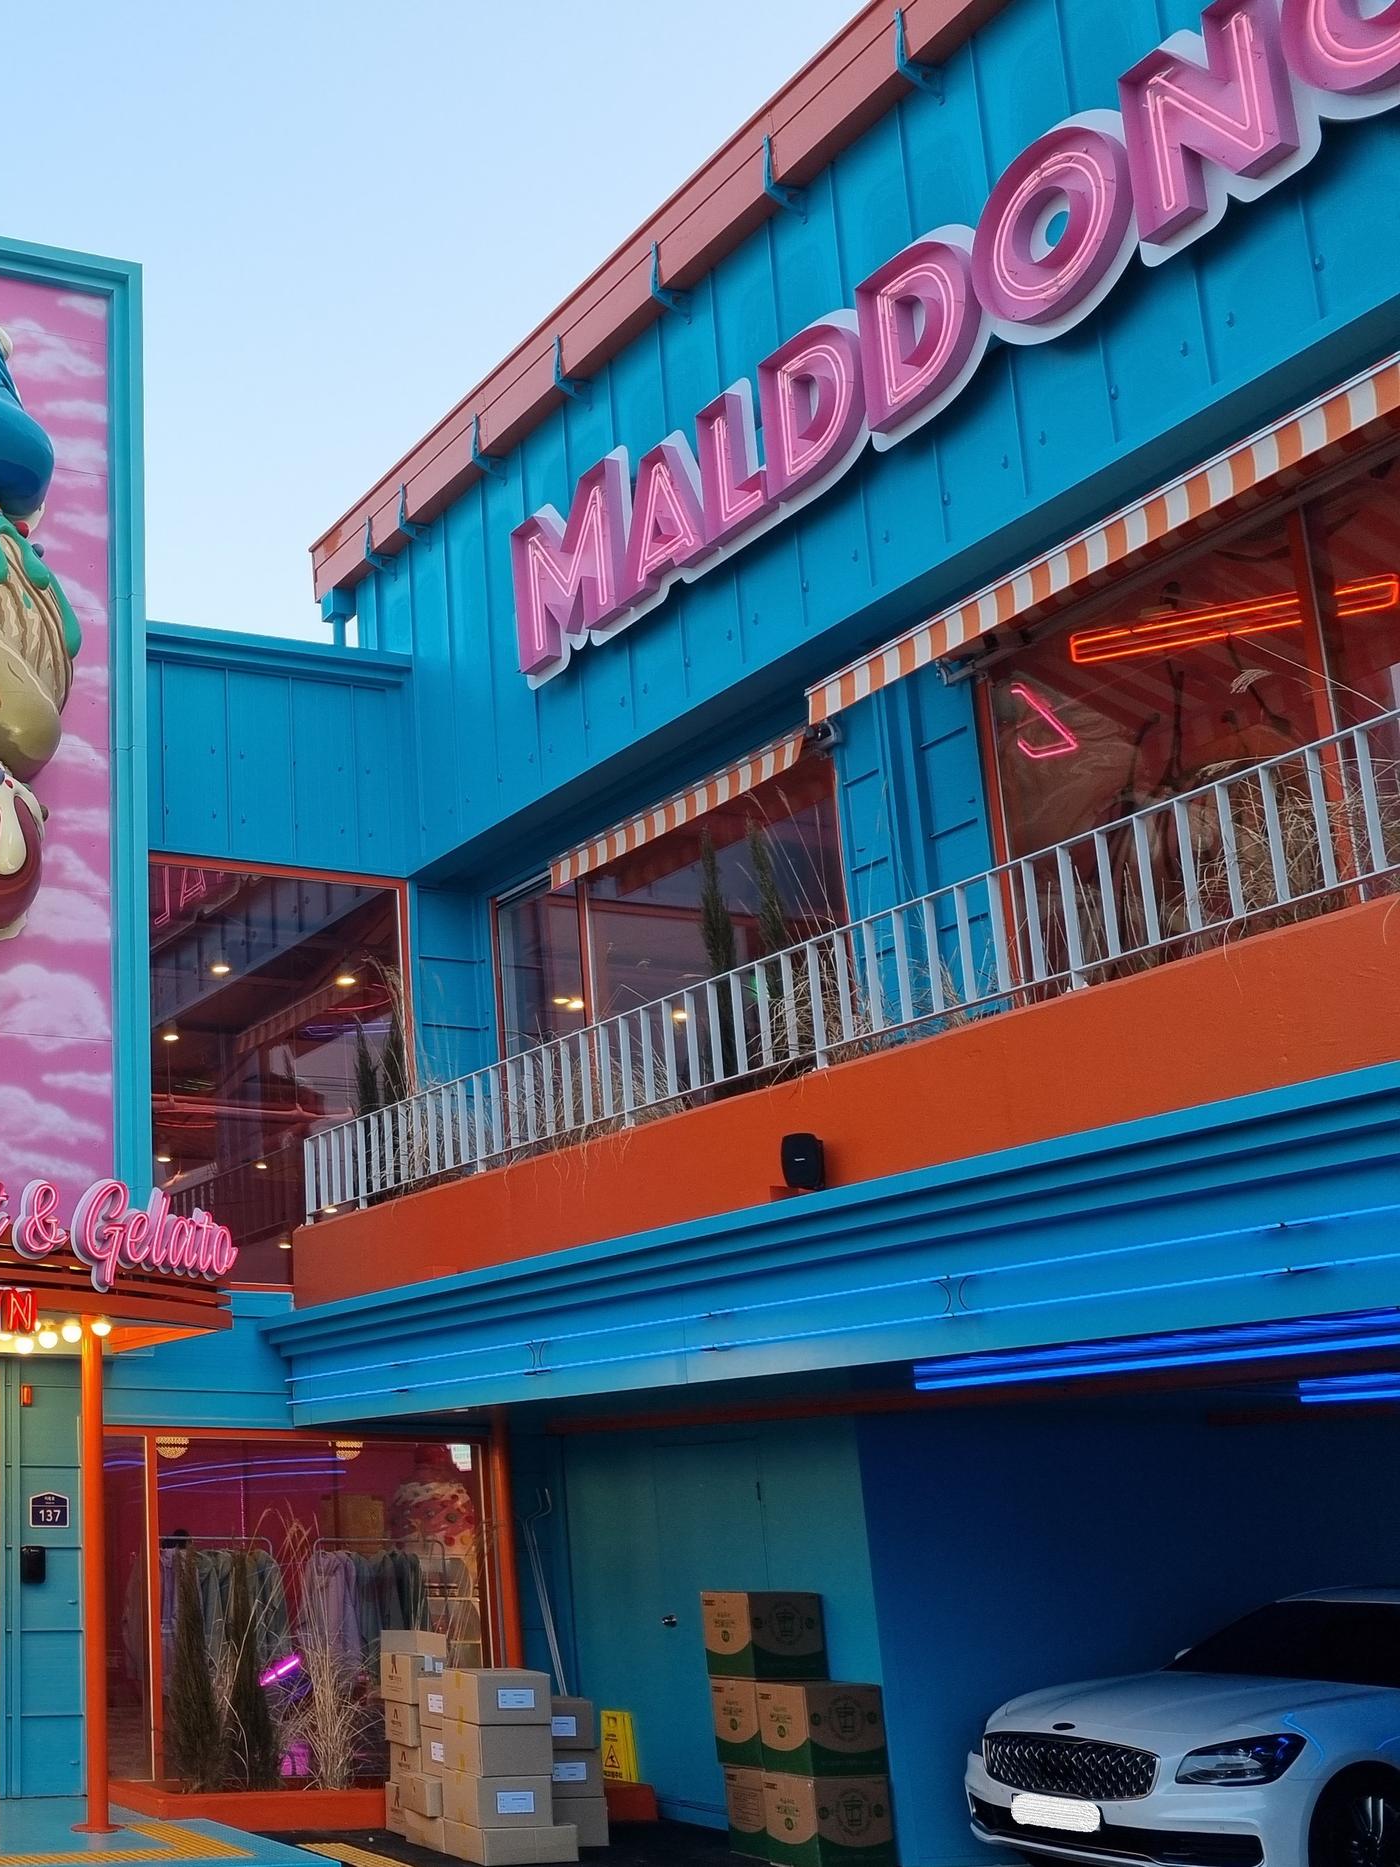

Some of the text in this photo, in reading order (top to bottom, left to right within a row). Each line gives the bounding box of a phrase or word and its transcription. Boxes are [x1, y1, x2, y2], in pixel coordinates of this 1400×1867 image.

[14, 1180, 68, 1257] &
[76, 1179, 239, 1291] Gelato
[39, 1509, 61, 1522] 137
